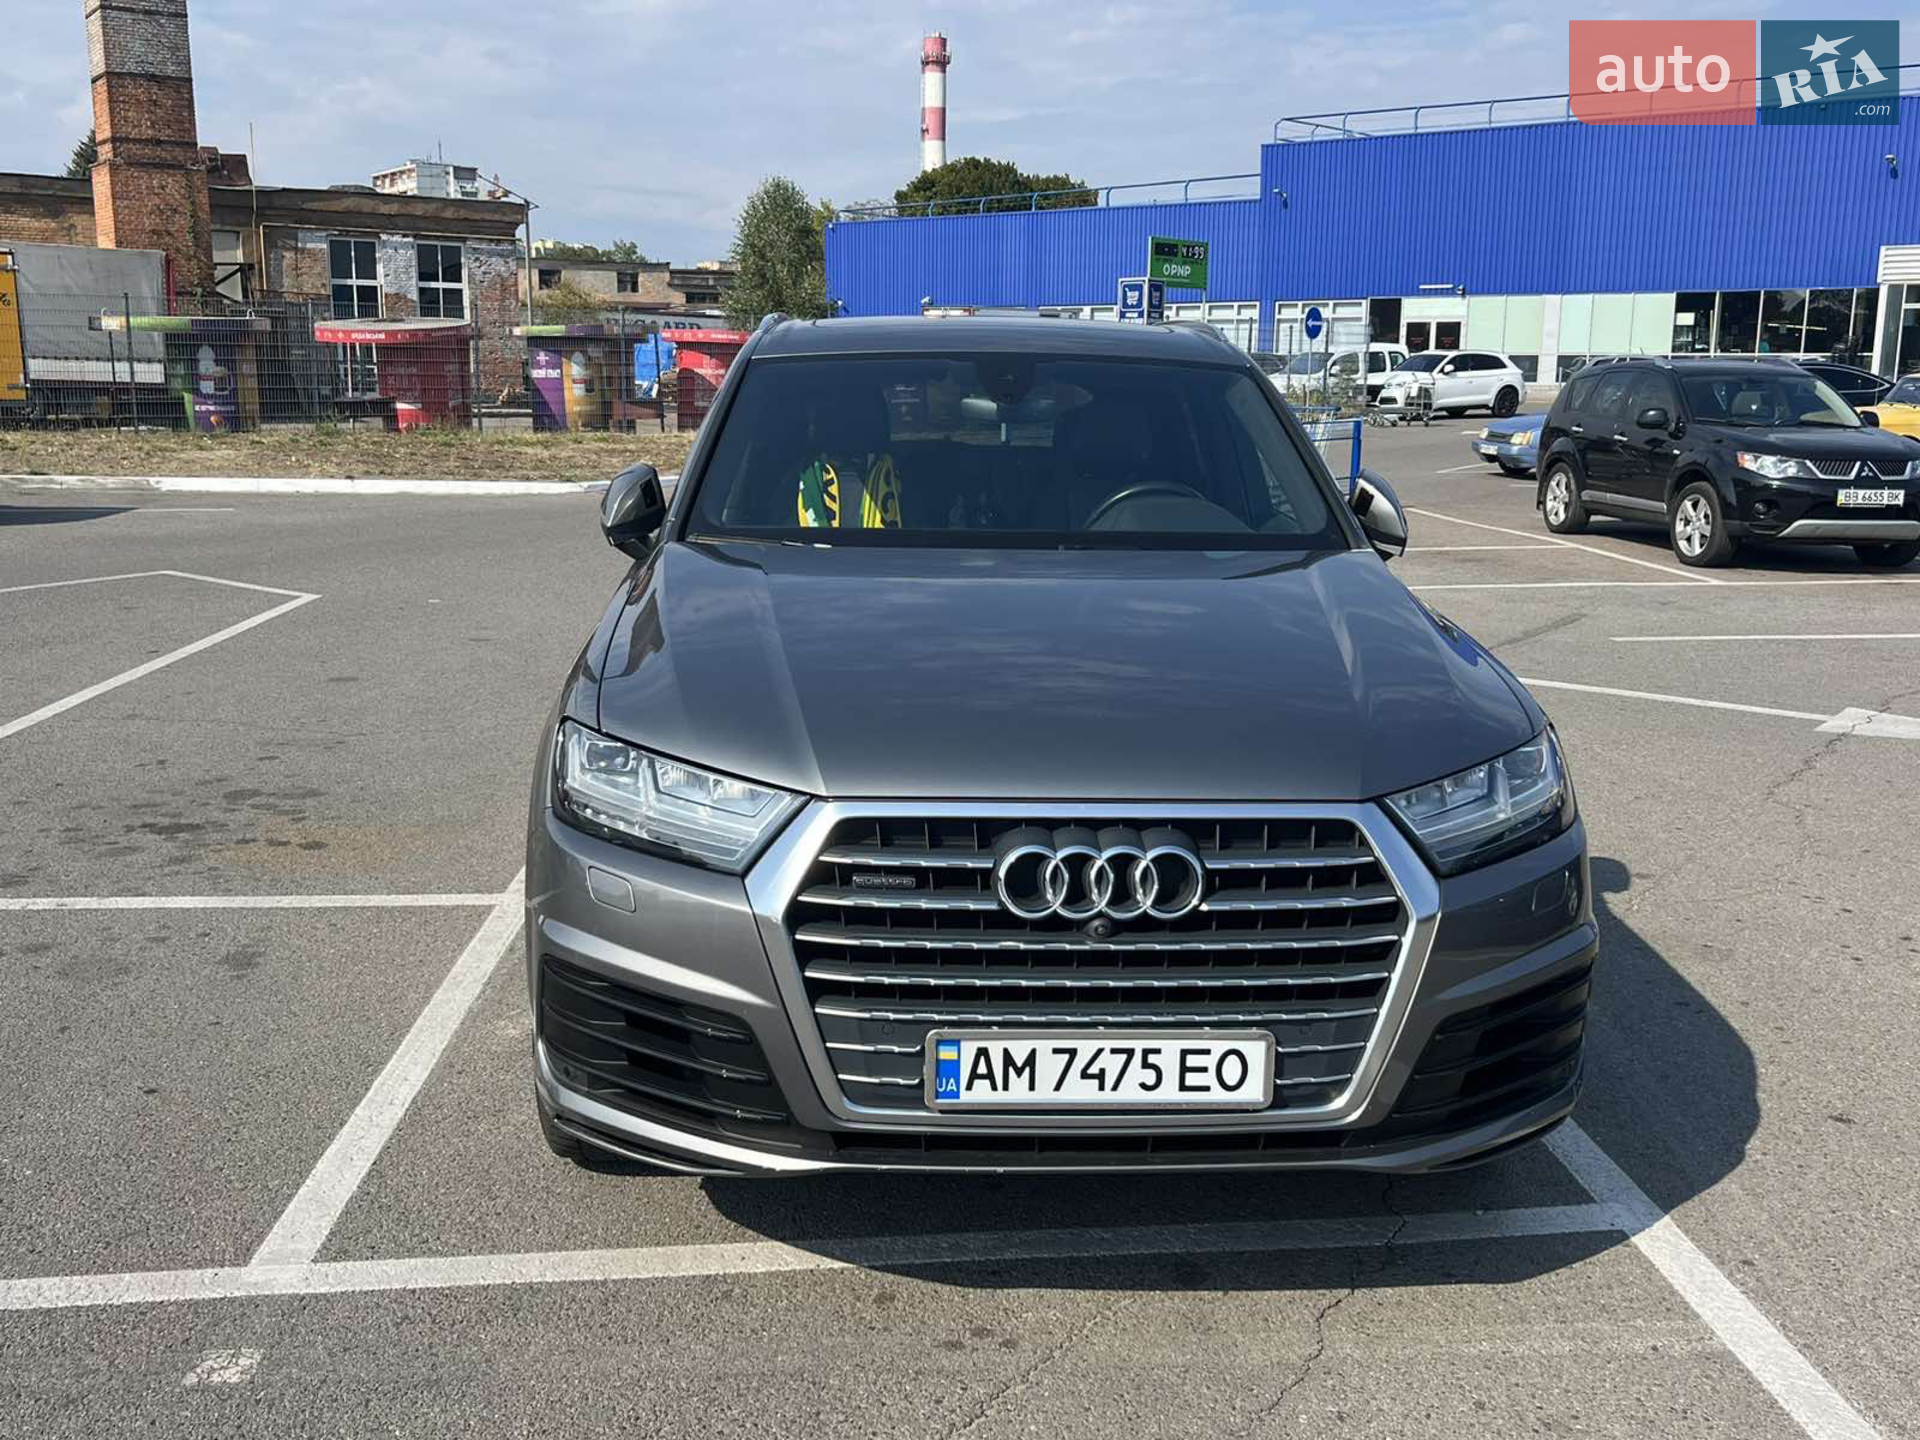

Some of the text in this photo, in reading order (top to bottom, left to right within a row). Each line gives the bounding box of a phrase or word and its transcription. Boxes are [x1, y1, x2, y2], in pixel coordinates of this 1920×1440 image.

[1844, 491, 1902, 502] BB 6655 BK
[965, 1046, 1248, 1092] AM 7475 EO
[936, 1078, 958, 1092] UA
